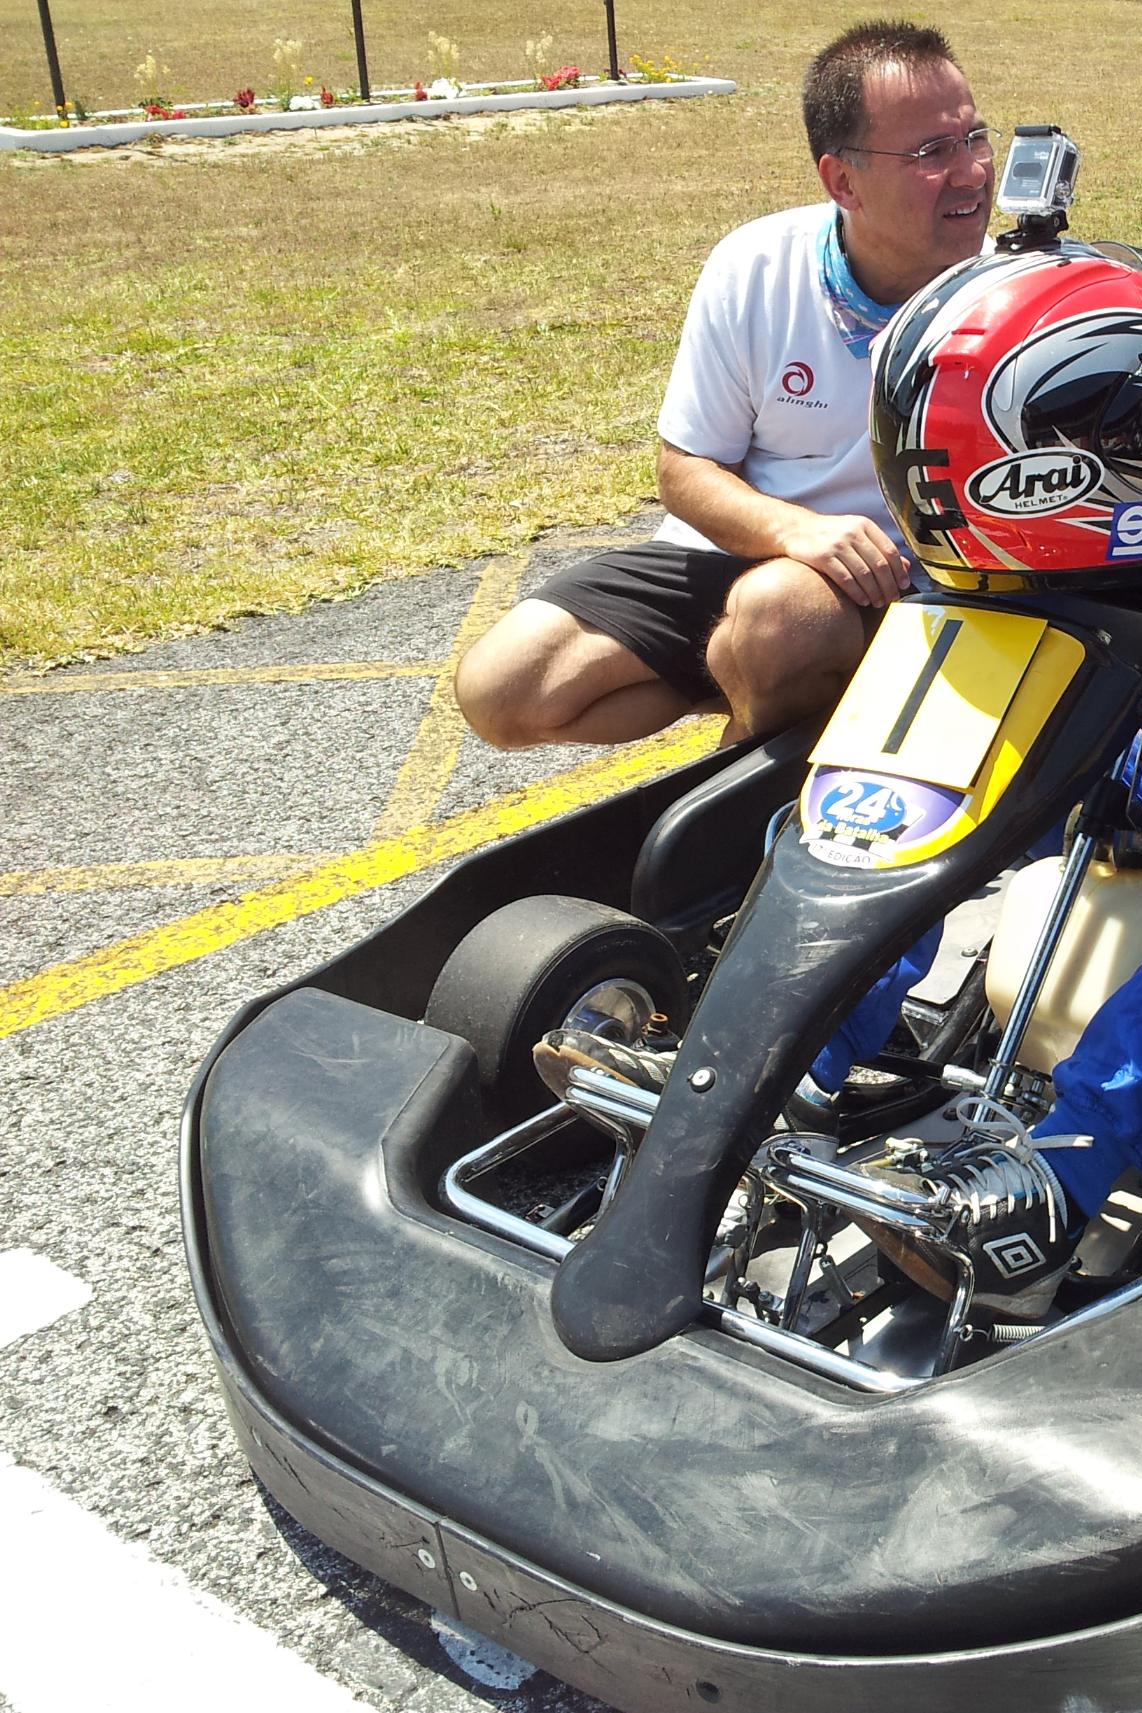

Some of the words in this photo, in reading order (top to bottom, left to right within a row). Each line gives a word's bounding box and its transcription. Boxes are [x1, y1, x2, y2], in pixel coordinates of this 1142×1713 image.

[776, 396, 829, 409] alinghi
[980, 454, 1087, 504] Arai
[1015, 494, 1062, 509] HELMET
[880, 618, 965, 755] 1
